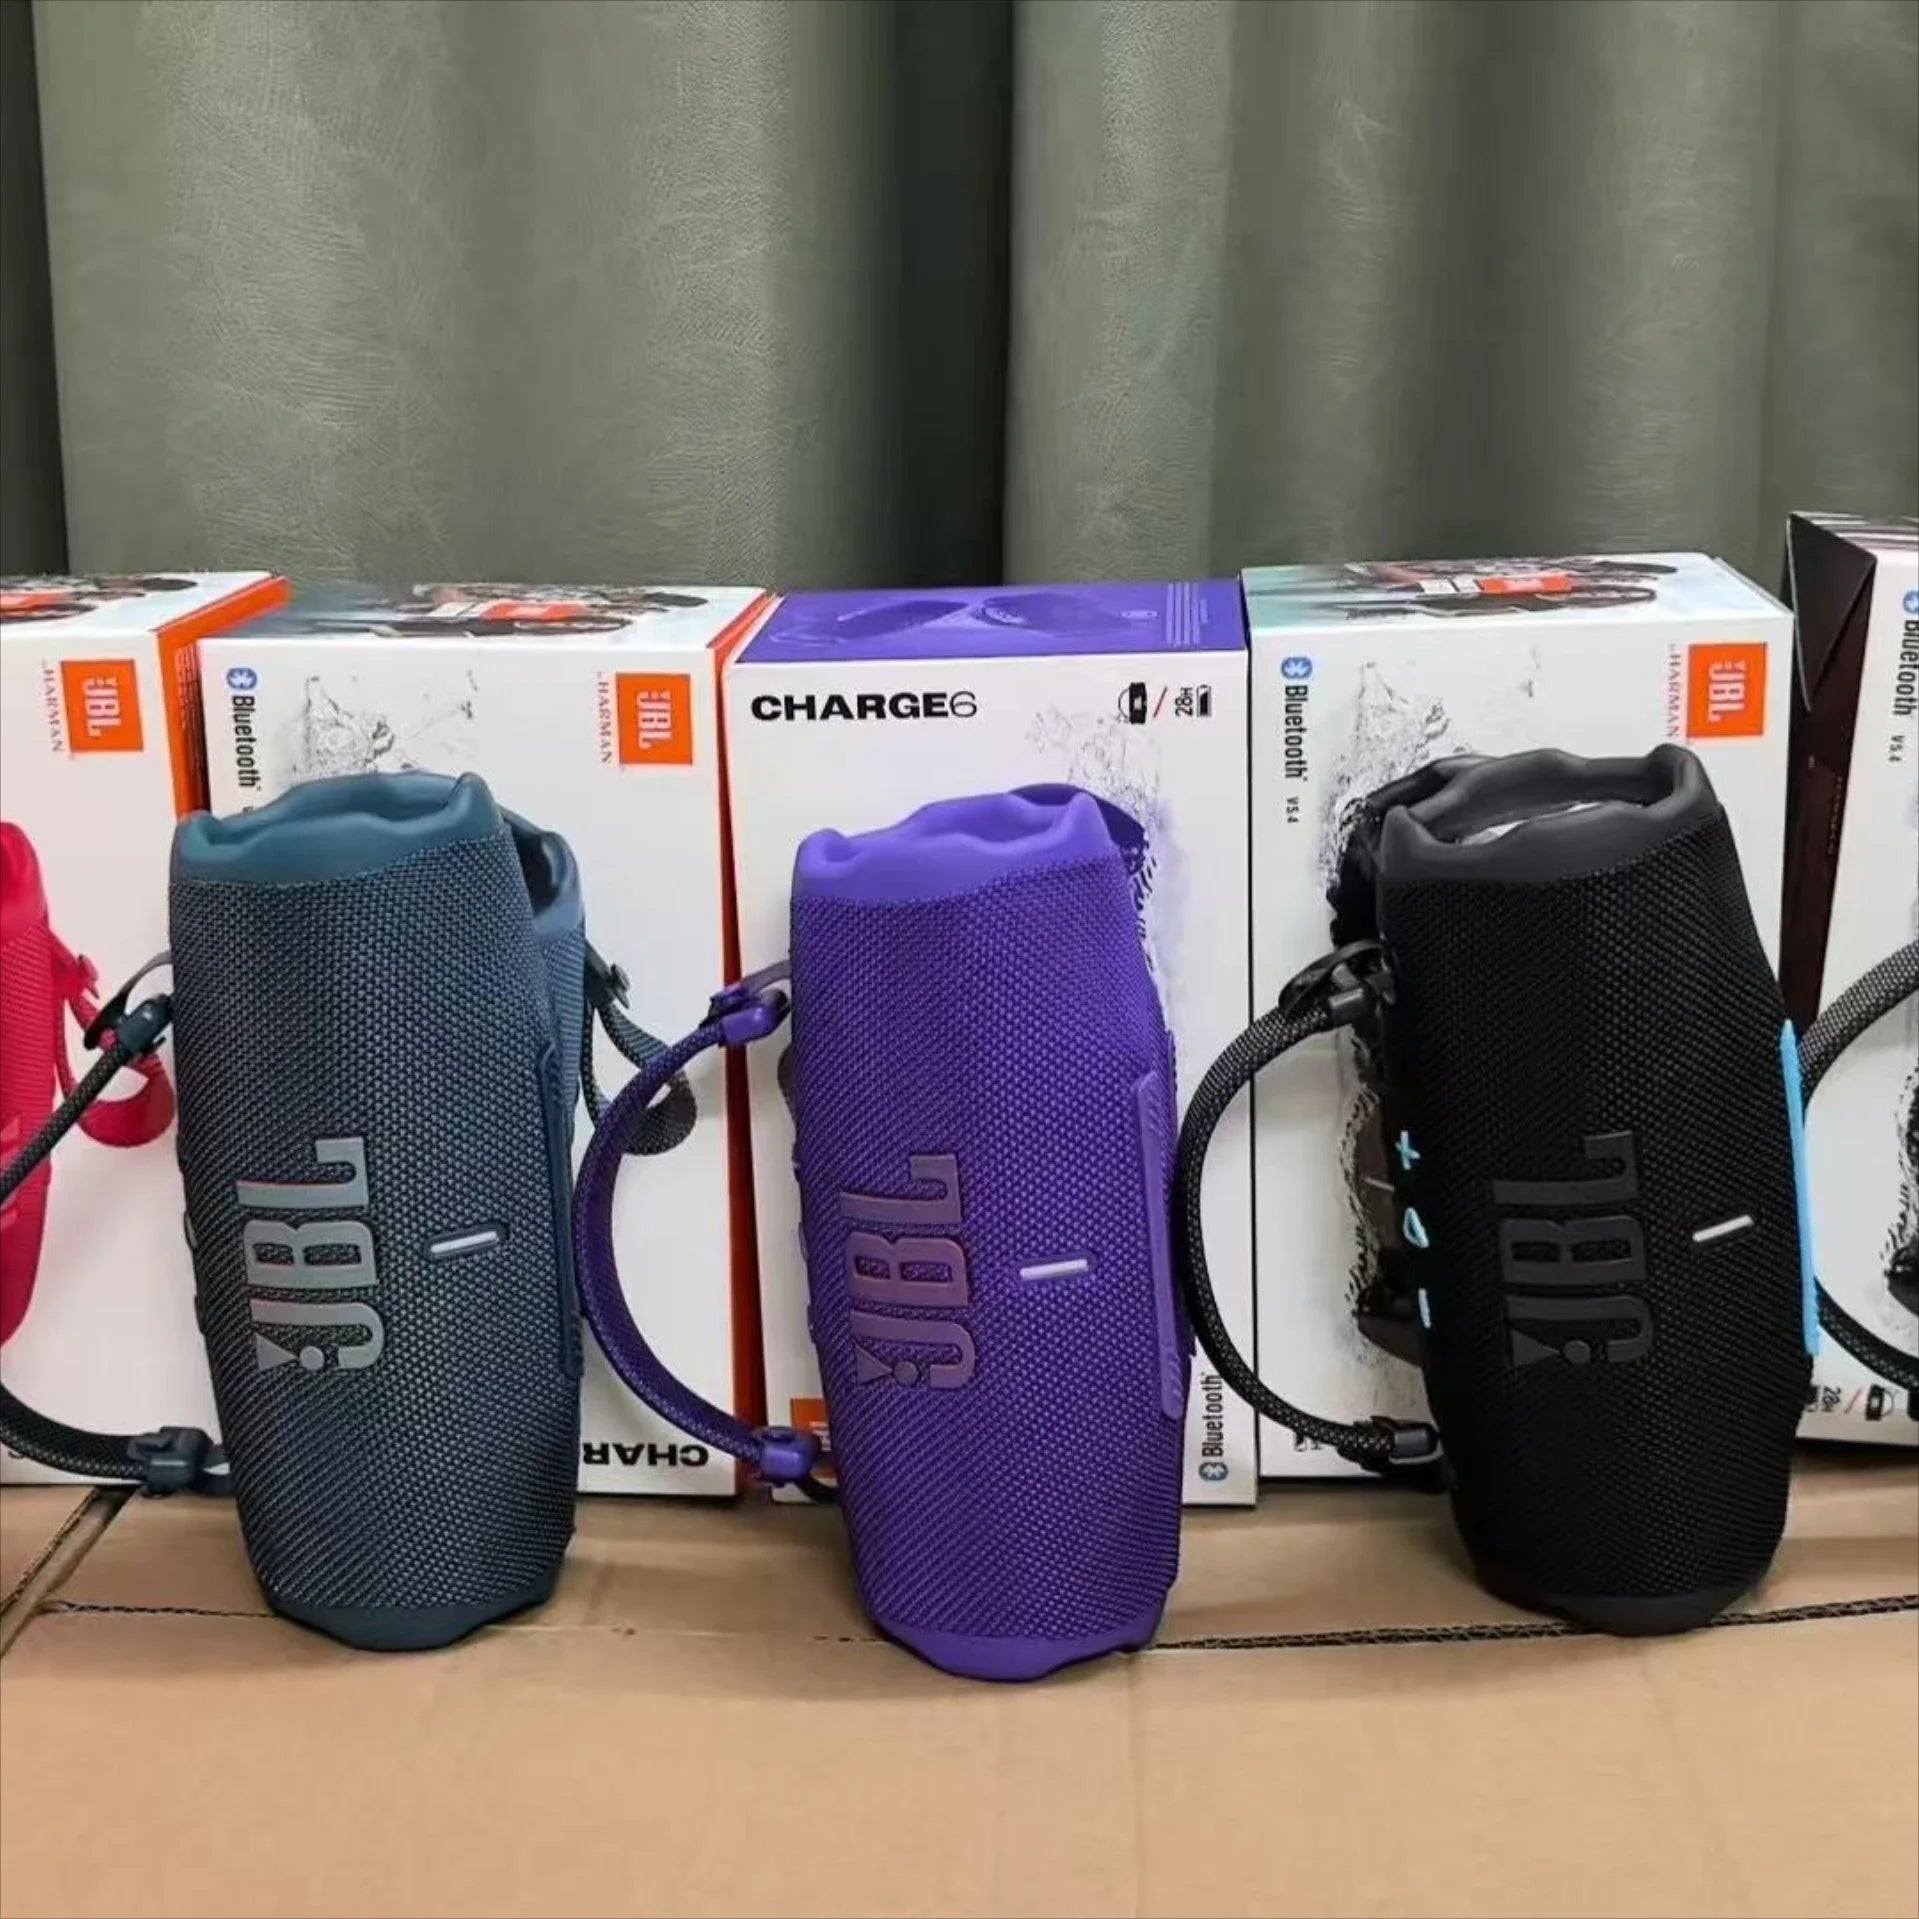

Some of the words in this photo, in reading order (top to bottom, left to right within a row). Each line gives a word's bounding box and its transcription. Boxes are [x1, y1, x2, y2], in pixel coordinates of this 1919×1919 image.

[82, 676, 122, 737] JBL
[636, 690, 673, 749] JBL
[750, 690, 978, 721] CHARGE6
[1284, 685, 1308, 780] Bluetooth
[1707, 660, 1746, 722] JBL
[232, 695, 261, 788] Bluetooth
[236, 1136, 385, 1371] JBL
[839, 1153, 976, 1389] JBL
[1493, 1129, 1655, 1368] JBL
[1200, 1373, 1225, 1458] Bluetooth
